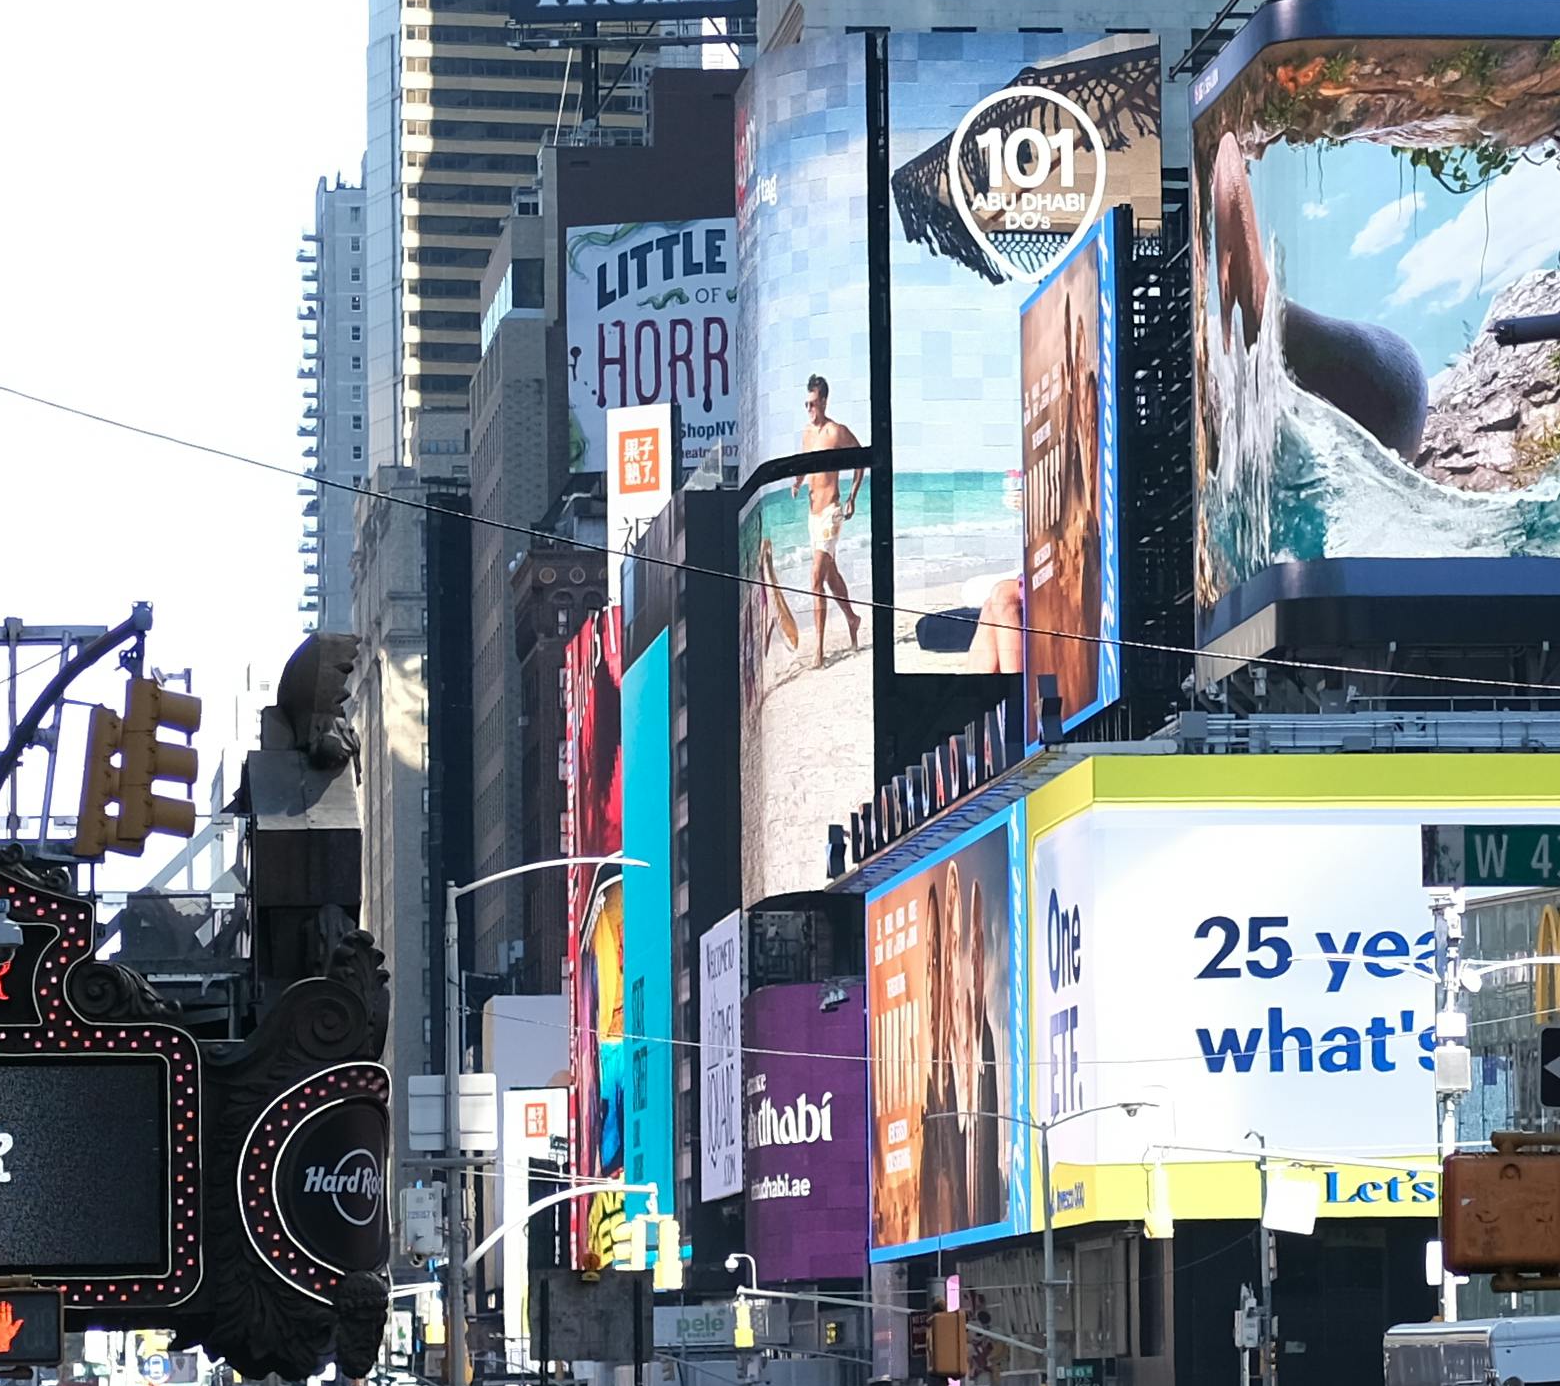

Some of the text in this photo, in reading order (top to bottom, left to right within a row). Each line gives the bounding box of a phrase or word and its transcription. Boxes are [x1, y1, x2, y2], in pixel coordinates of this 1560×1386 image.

[975, 126, 1075, 189] 101
[971, 192, 1086, 212] ABU DHABI
[596, 228, 727, 312] LITTLE
[695, 287, 721, 304] OF
[596, 316, 738, 413] HORR
[1474, 833, 1509, 879] W
[1047, 888, 1081, 994] One
[1193, 915, 1293, 980] 25
[1050, 1004, 1084, 1117] ETF.
[303, 1166, 361, 1193] Hard
[1324, 1169, 1437, 1204] Let's
